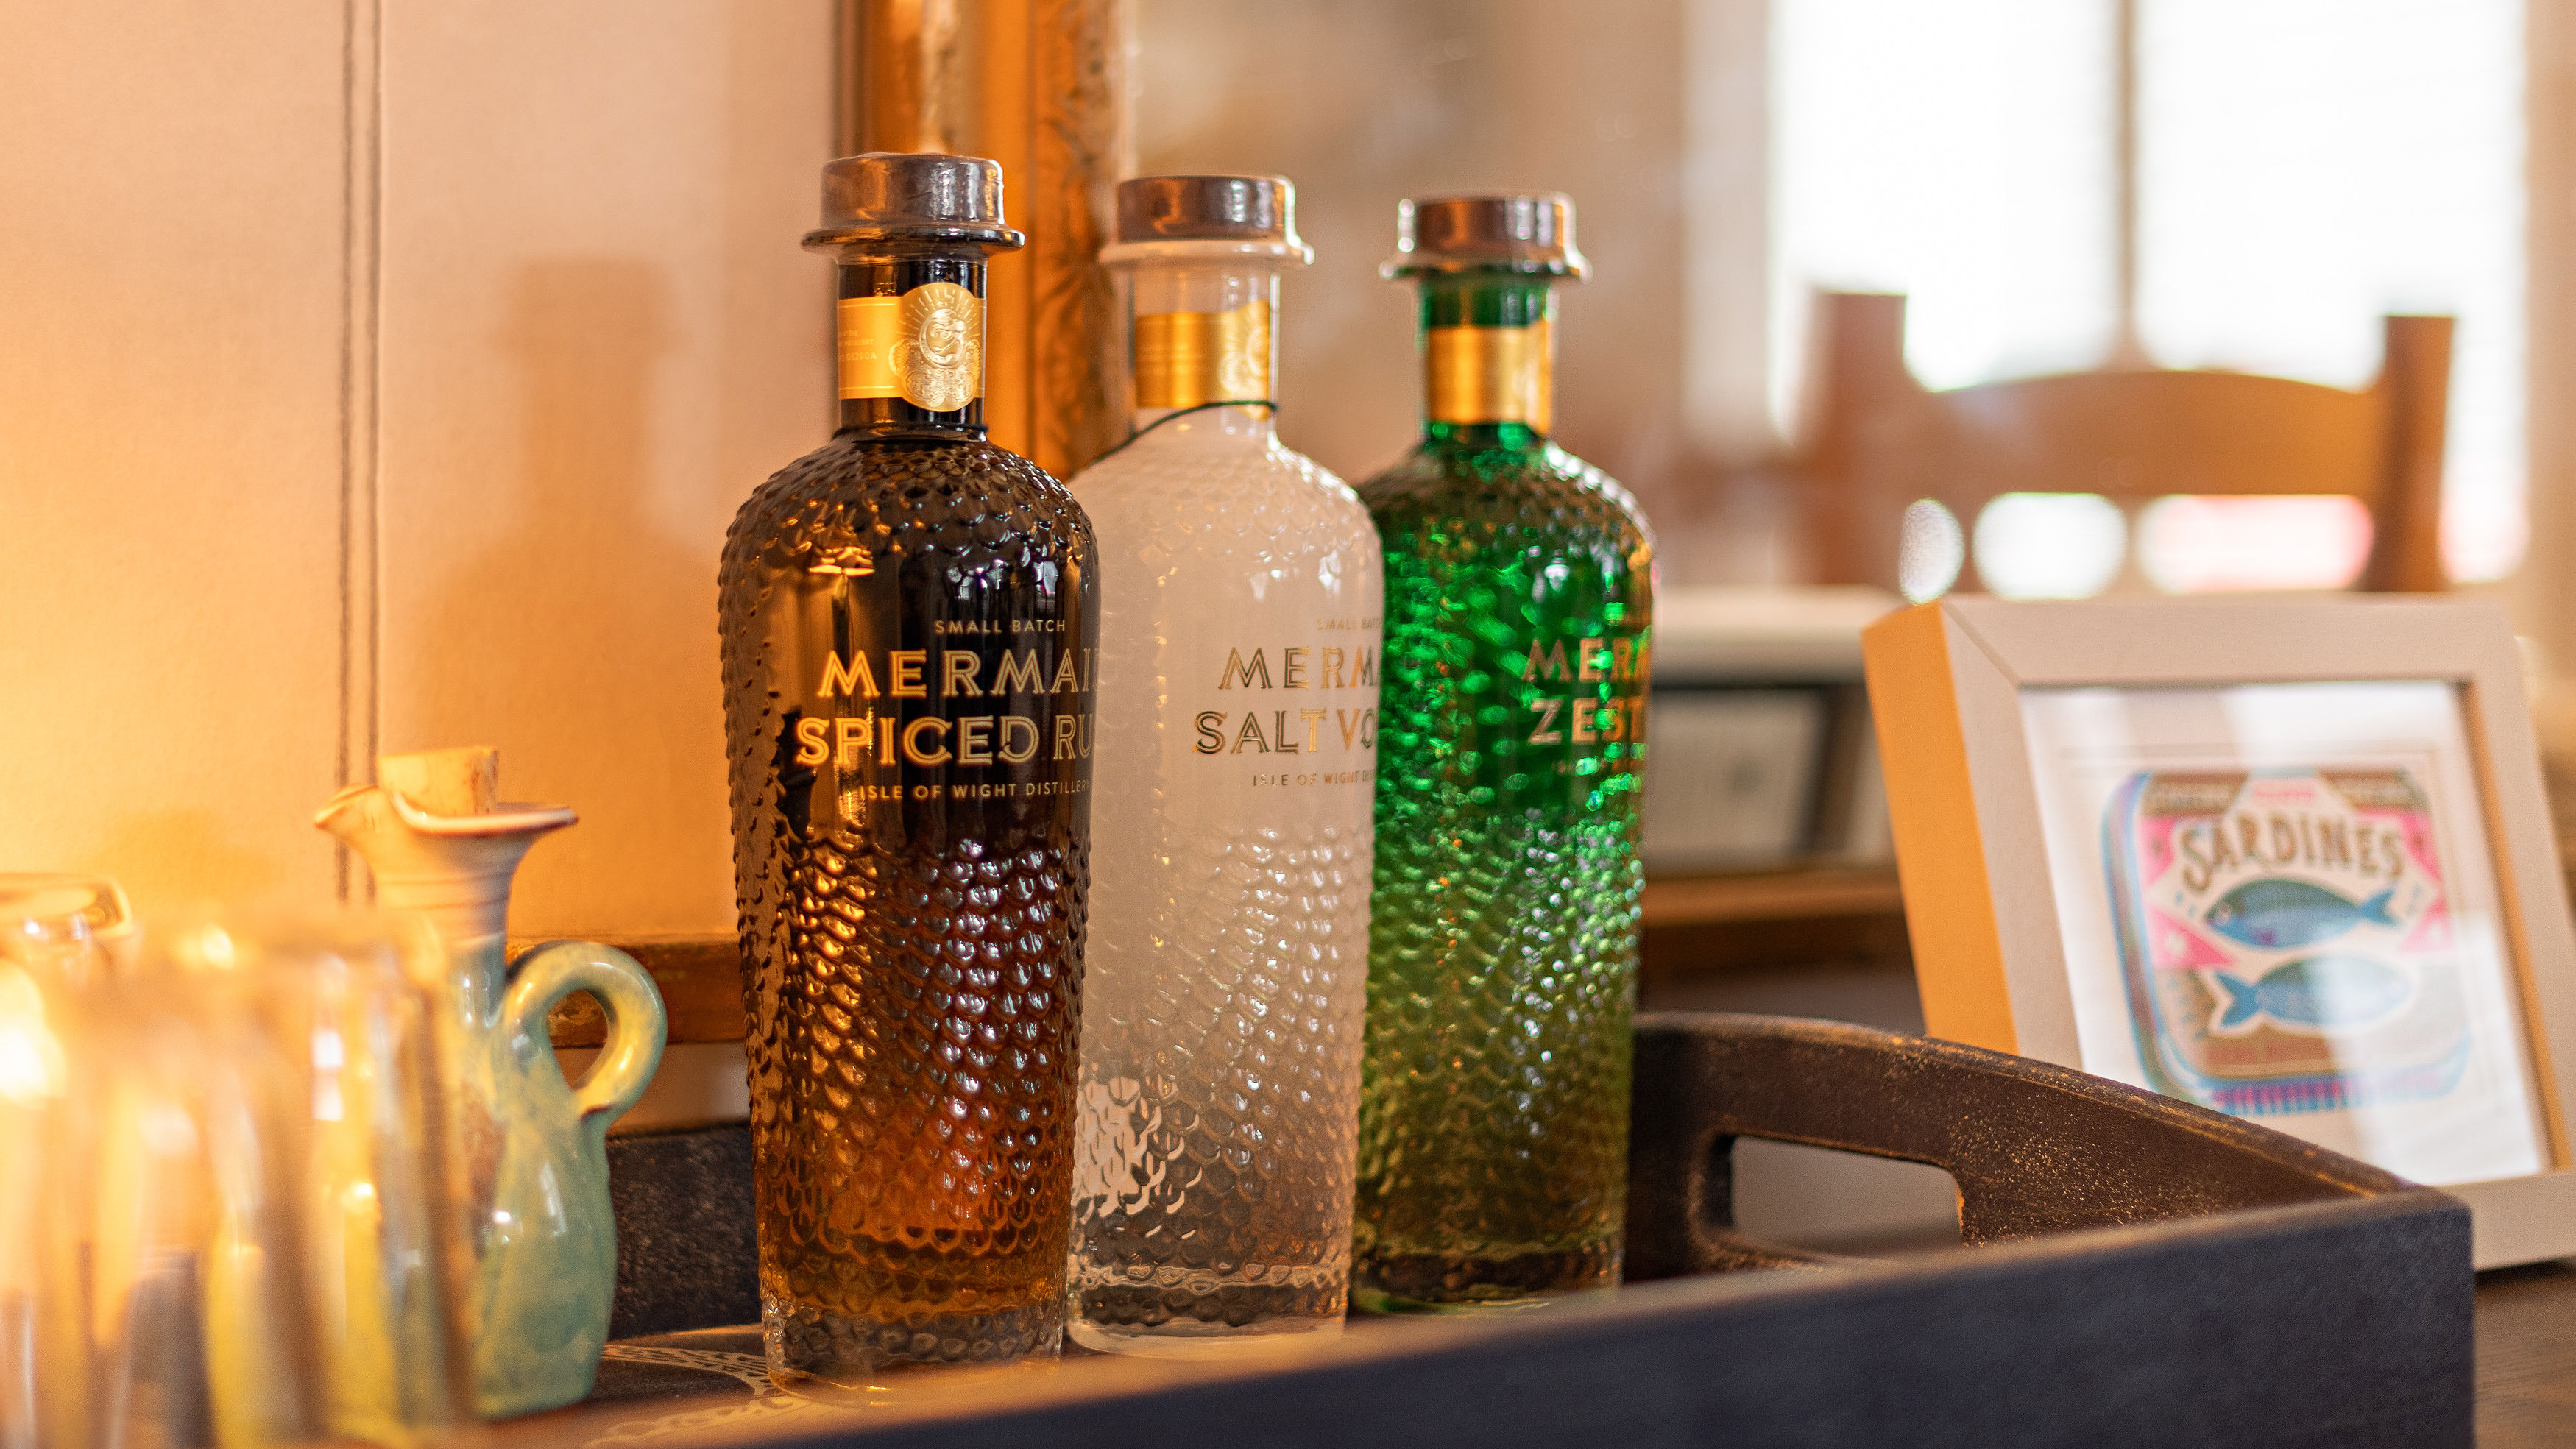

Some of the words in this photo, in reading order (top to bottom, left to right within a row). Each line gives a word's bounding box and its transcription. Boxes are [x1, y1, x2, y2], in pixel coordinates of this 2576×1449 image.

[935, 620, 1002, 634] SMALL
[1013, 619, 1066, 633] BATCH
[1317, 617, 1357, 631] SMALL
[795, 714, 1038, 767] SPICED
[1192, 707, 1327, 755] SALT
[1253, 773, 1289, 787] ISLE
[1297, 773, 1317, 786] OF
[1324, 770, 1360, 785] WIGHT
[860, 784, 903, 800] ISLE
[913, 784, 942, 801] OF
[952, 782, 1017, 799] WIGHT
[2181, 812, 2405, 893] SARDINES
